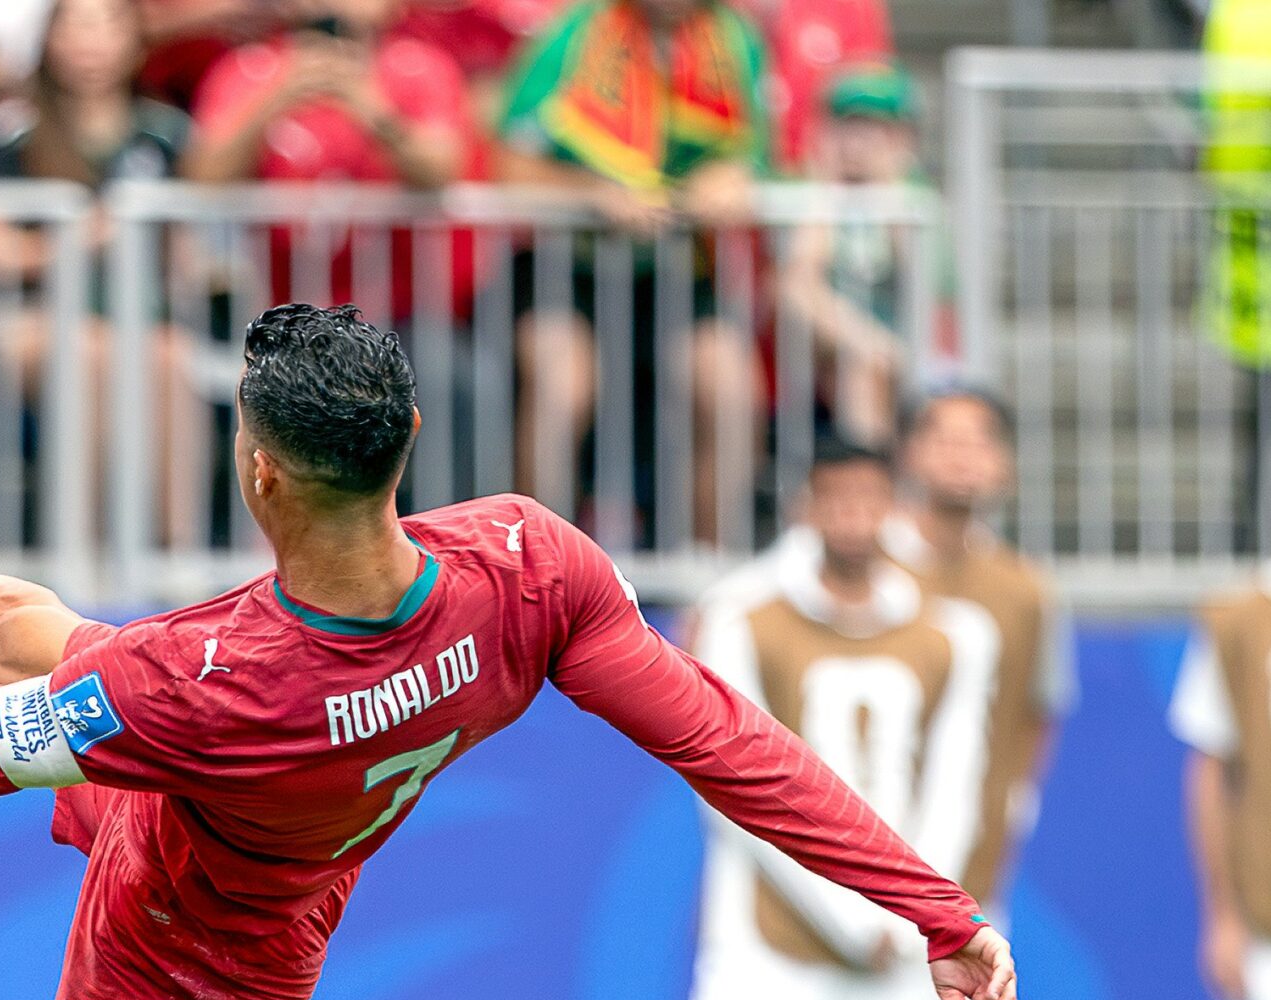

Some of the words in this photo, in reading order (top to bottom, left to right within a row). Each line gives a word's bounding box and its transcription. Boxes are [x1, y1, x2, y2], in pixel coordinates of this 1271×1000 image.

[22, 689, 46, 755] UNITES
[36, 684, 58, 748] OOTBALL
[324, 633, 479, 746] RONALDO
[4, 714, 31, 762] World
[330, 725, 463, 860] 7
